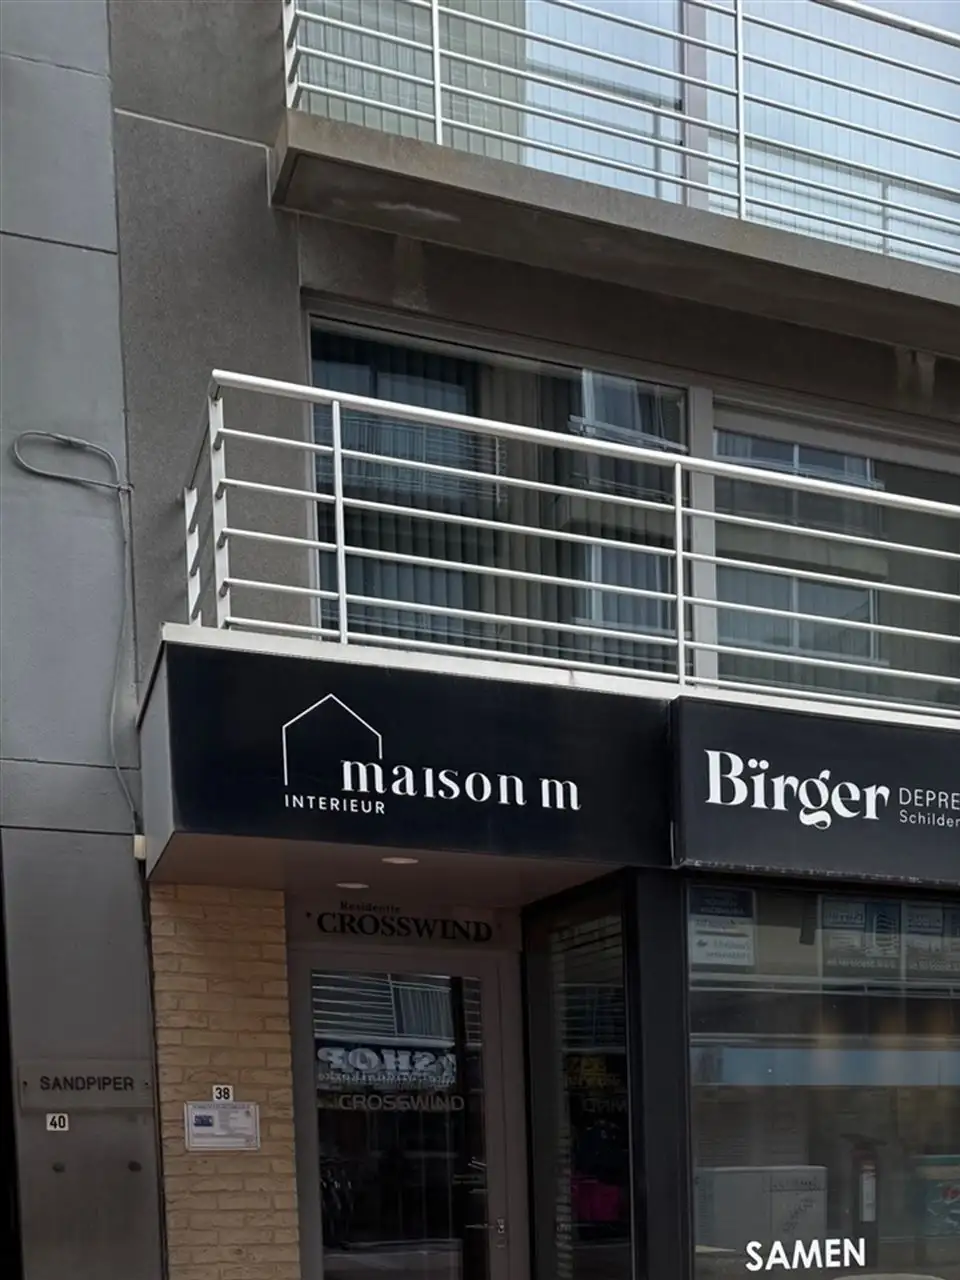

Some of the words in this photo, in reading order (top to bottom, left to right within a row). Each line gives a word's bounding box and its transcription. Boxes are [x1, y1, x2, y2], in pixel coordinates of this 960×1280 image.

[340, 759, 527, 805] maison
[539, 778, 582, 810] m
[285, 794, 386, 815] INTERIEUR
[317, 911, 492, 942] CROSSWIND
[39, 1075, 135, 1091] SANDPIPER
[215, 1087, 230, 1100] 38
[338, 1094, 465, 1111] CROSSWIND
[49, 1115, 66, 1129] 40
[745, 1238, 866, 1271] SAMEN
